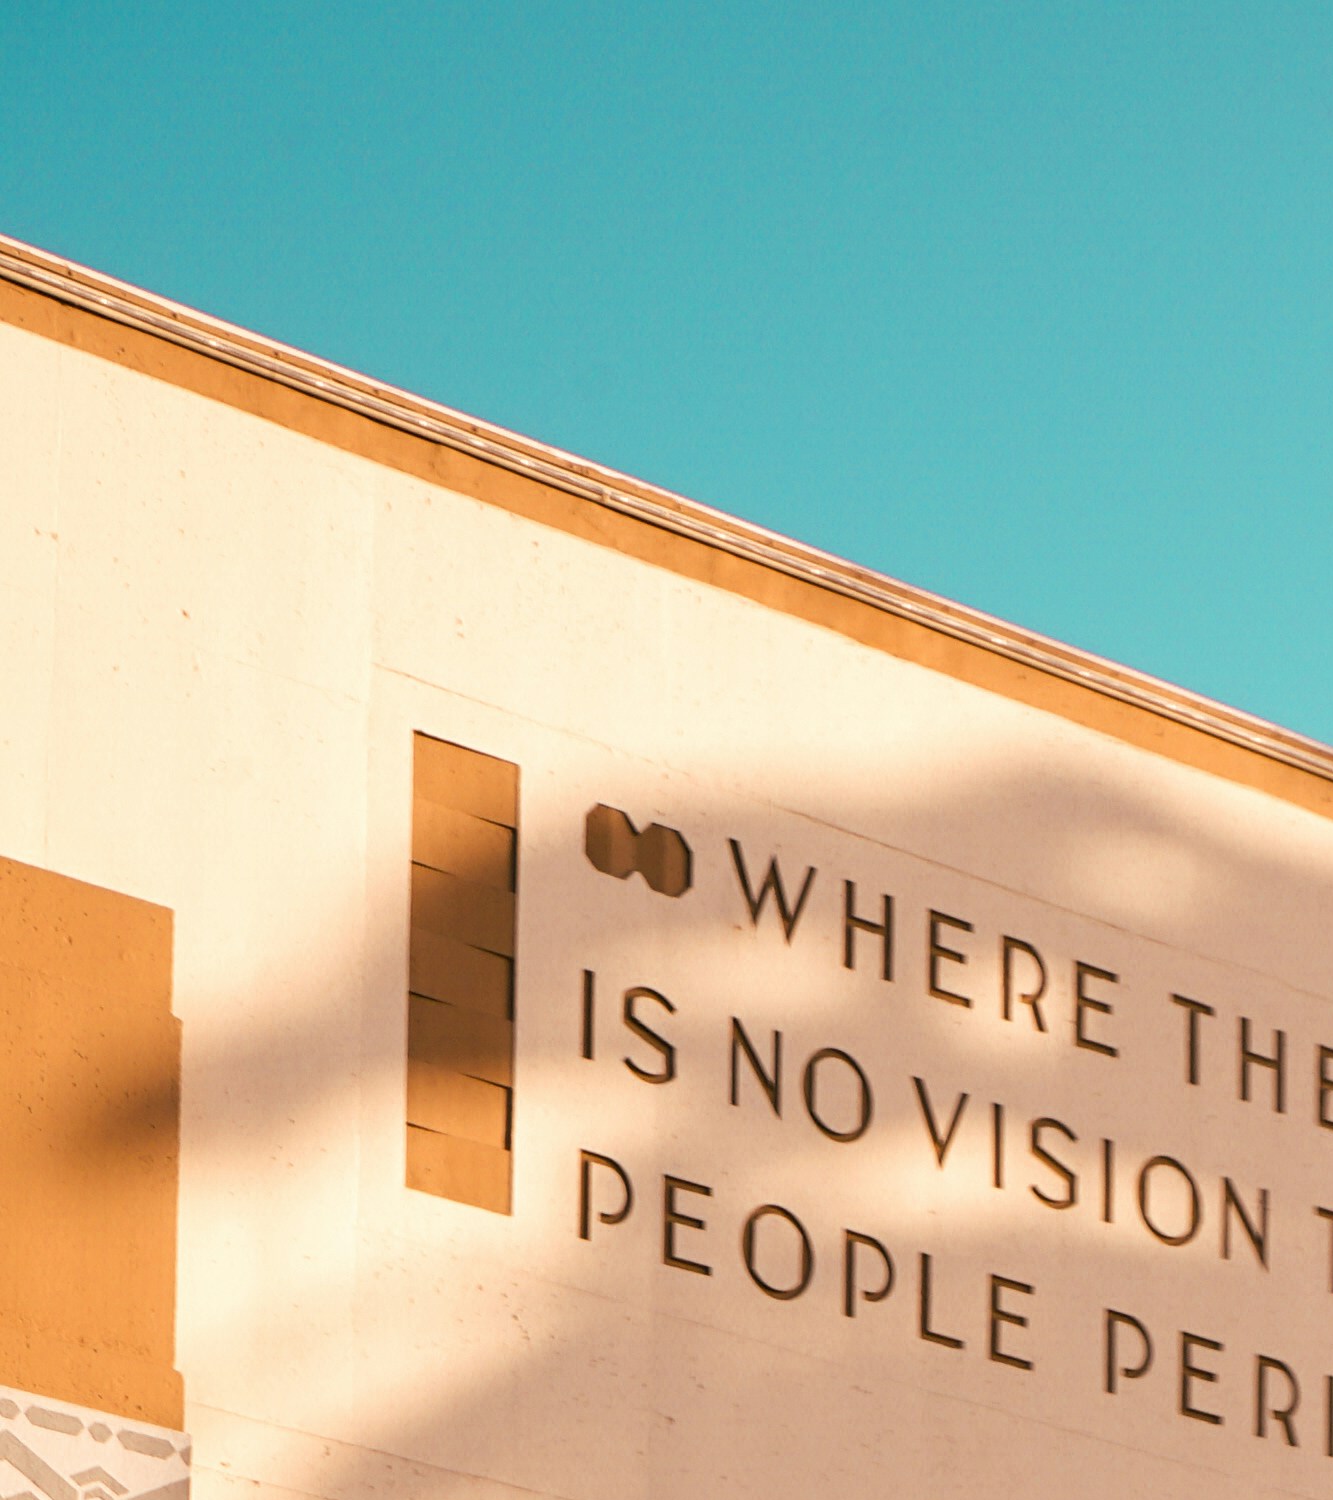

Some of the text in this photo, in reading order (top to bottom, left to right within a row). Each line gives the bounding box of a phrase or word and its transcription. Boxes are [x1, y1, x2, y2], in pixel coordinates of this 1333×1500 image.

[730, 838, 1121, 1058] WHERE
[580, 970, 677, 1084] IS
[730, 1017, 874, 1144] NO
[911, 1076, 1271, 1271] VISION
[578, 1150, 1035, 1370] PEOPLE
